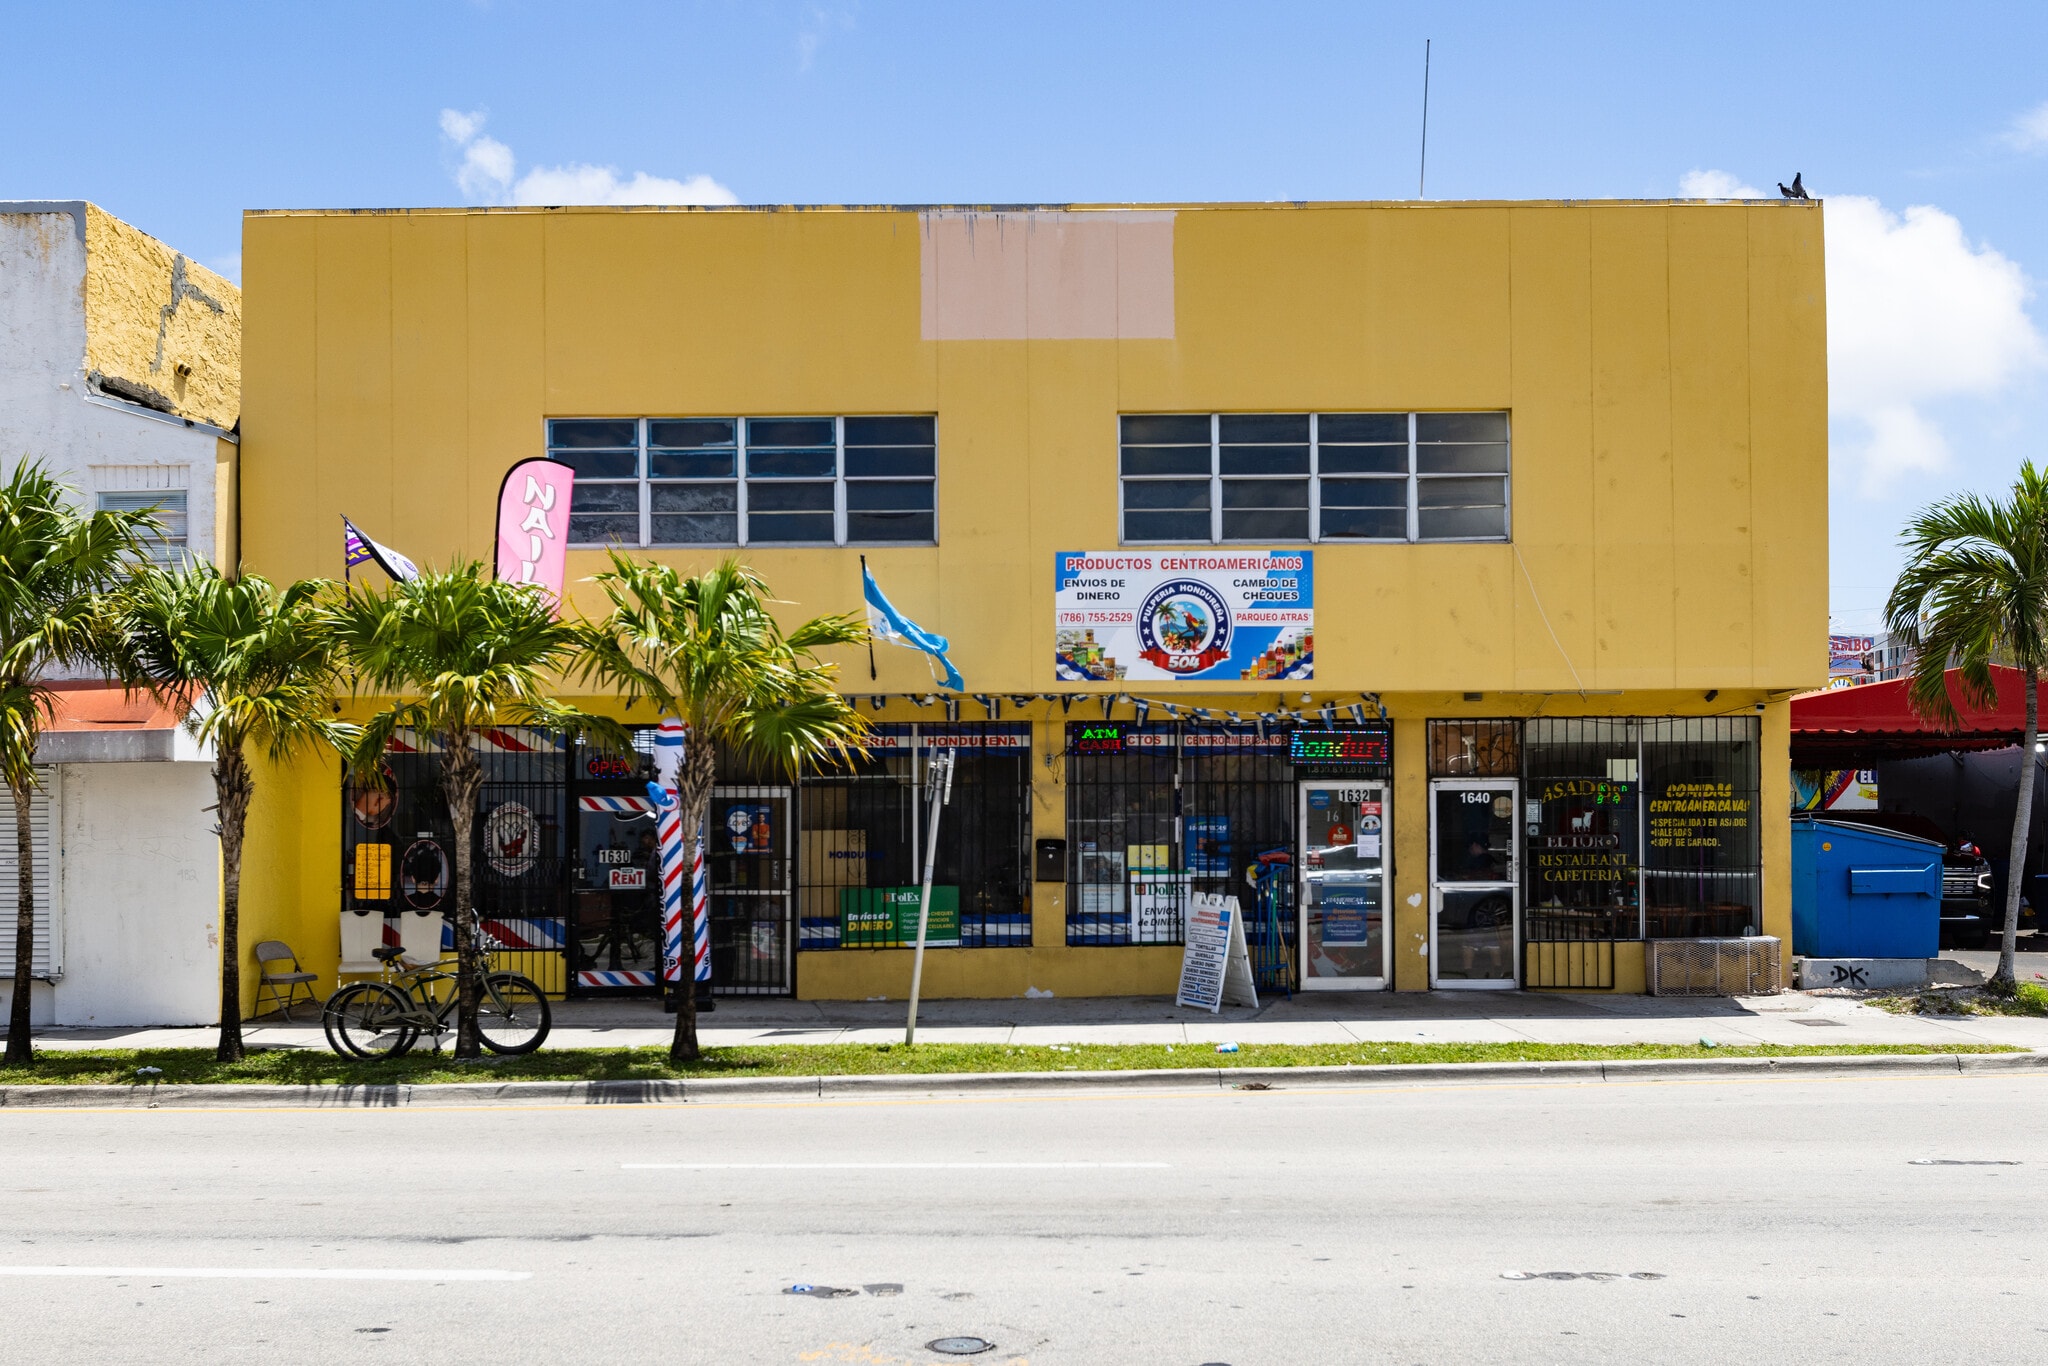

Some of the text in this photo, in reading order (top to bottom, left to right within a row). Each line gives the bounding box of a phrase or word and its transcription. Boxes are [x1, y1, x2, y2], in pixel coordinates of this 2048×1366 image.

[519, 475, 556, 600] NAIL
[1066, 557, 1303, 570] PRODUCTOS CENTROAMERICANOS
[1064, 579, 1126, 588] ENVIOS DE
[1232, 579, 1297, 588] CAMBIO DE
[1076, 591, 1121, 601] DINERO
[1242, 591, 1298, 601] CHEQUES
[1142, 584, 1224, 623] PULPERIA HONDUREÑA
[1060, 612, 1133, 624] (786) 755-2529
[1236, 613, 1308, 622] PARQUEO ATRAS
[1831, 637, 1872, 652] AMBO
[1168, 655, 1200, 670] 504
[1081, 728, 1118, 739] ATM
[927, 736, 1018, 746] HONDUREÑA
[1079, 739, 1122, 750] CASH
[1860, 770, 1874, 784] EL
[1341, 789, 1369, 802] 1632
[1665, 783, 1733, 798] COMIDAS
[1460, 793, 1490, 804] 1640
[1708, 818, 1718, 827] EN
[601, 850, 629, 863] 1630
[1539, 854, 1628, 866] RESTAURANT
[612, 871, 643, 885] RENT
[1544, 870, 1623, 881] CAFETERIA
[891, 892, 920, 902] DolEx
[848, 920, 893, 932] DINERO
